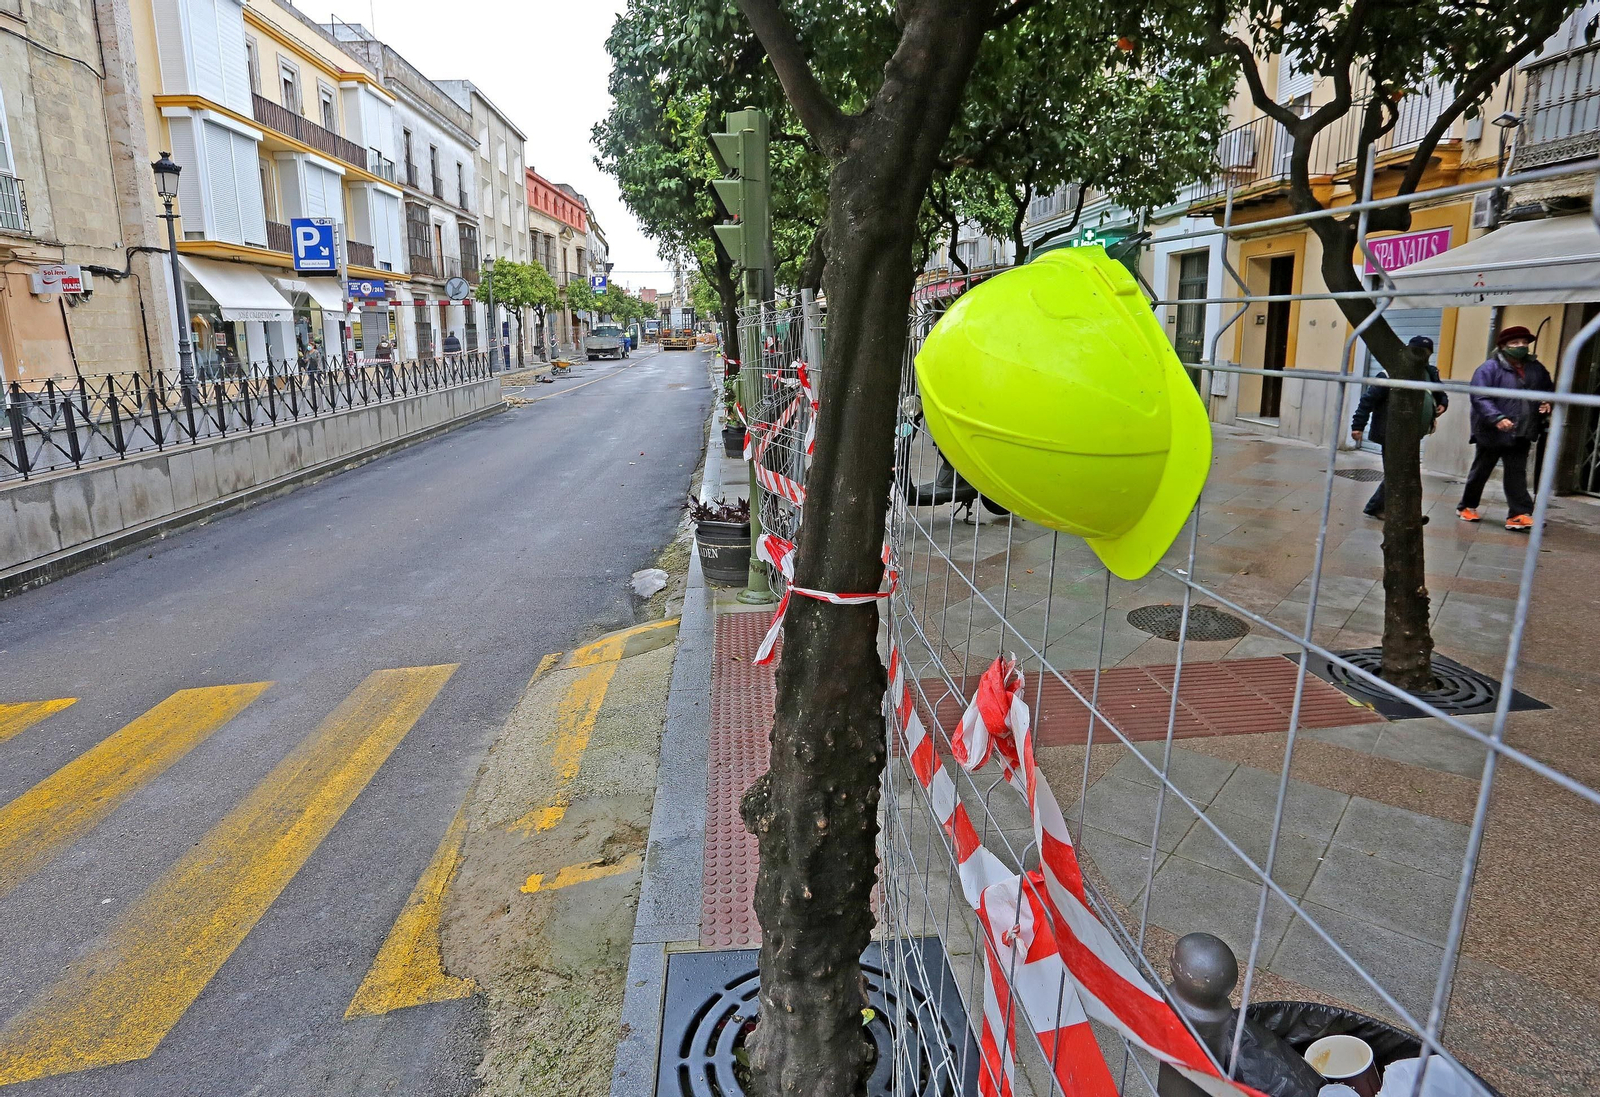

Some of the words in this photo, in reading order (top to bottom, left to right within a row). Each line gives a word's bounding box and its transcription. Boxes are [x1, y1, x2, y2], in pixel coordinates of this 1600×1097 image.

[296, 226, 320, 259] P
[1373, 242, 1395, 270] SPA
[1397, 235, 1439, 267] NAILS
[595, 276, 603, 286] P
